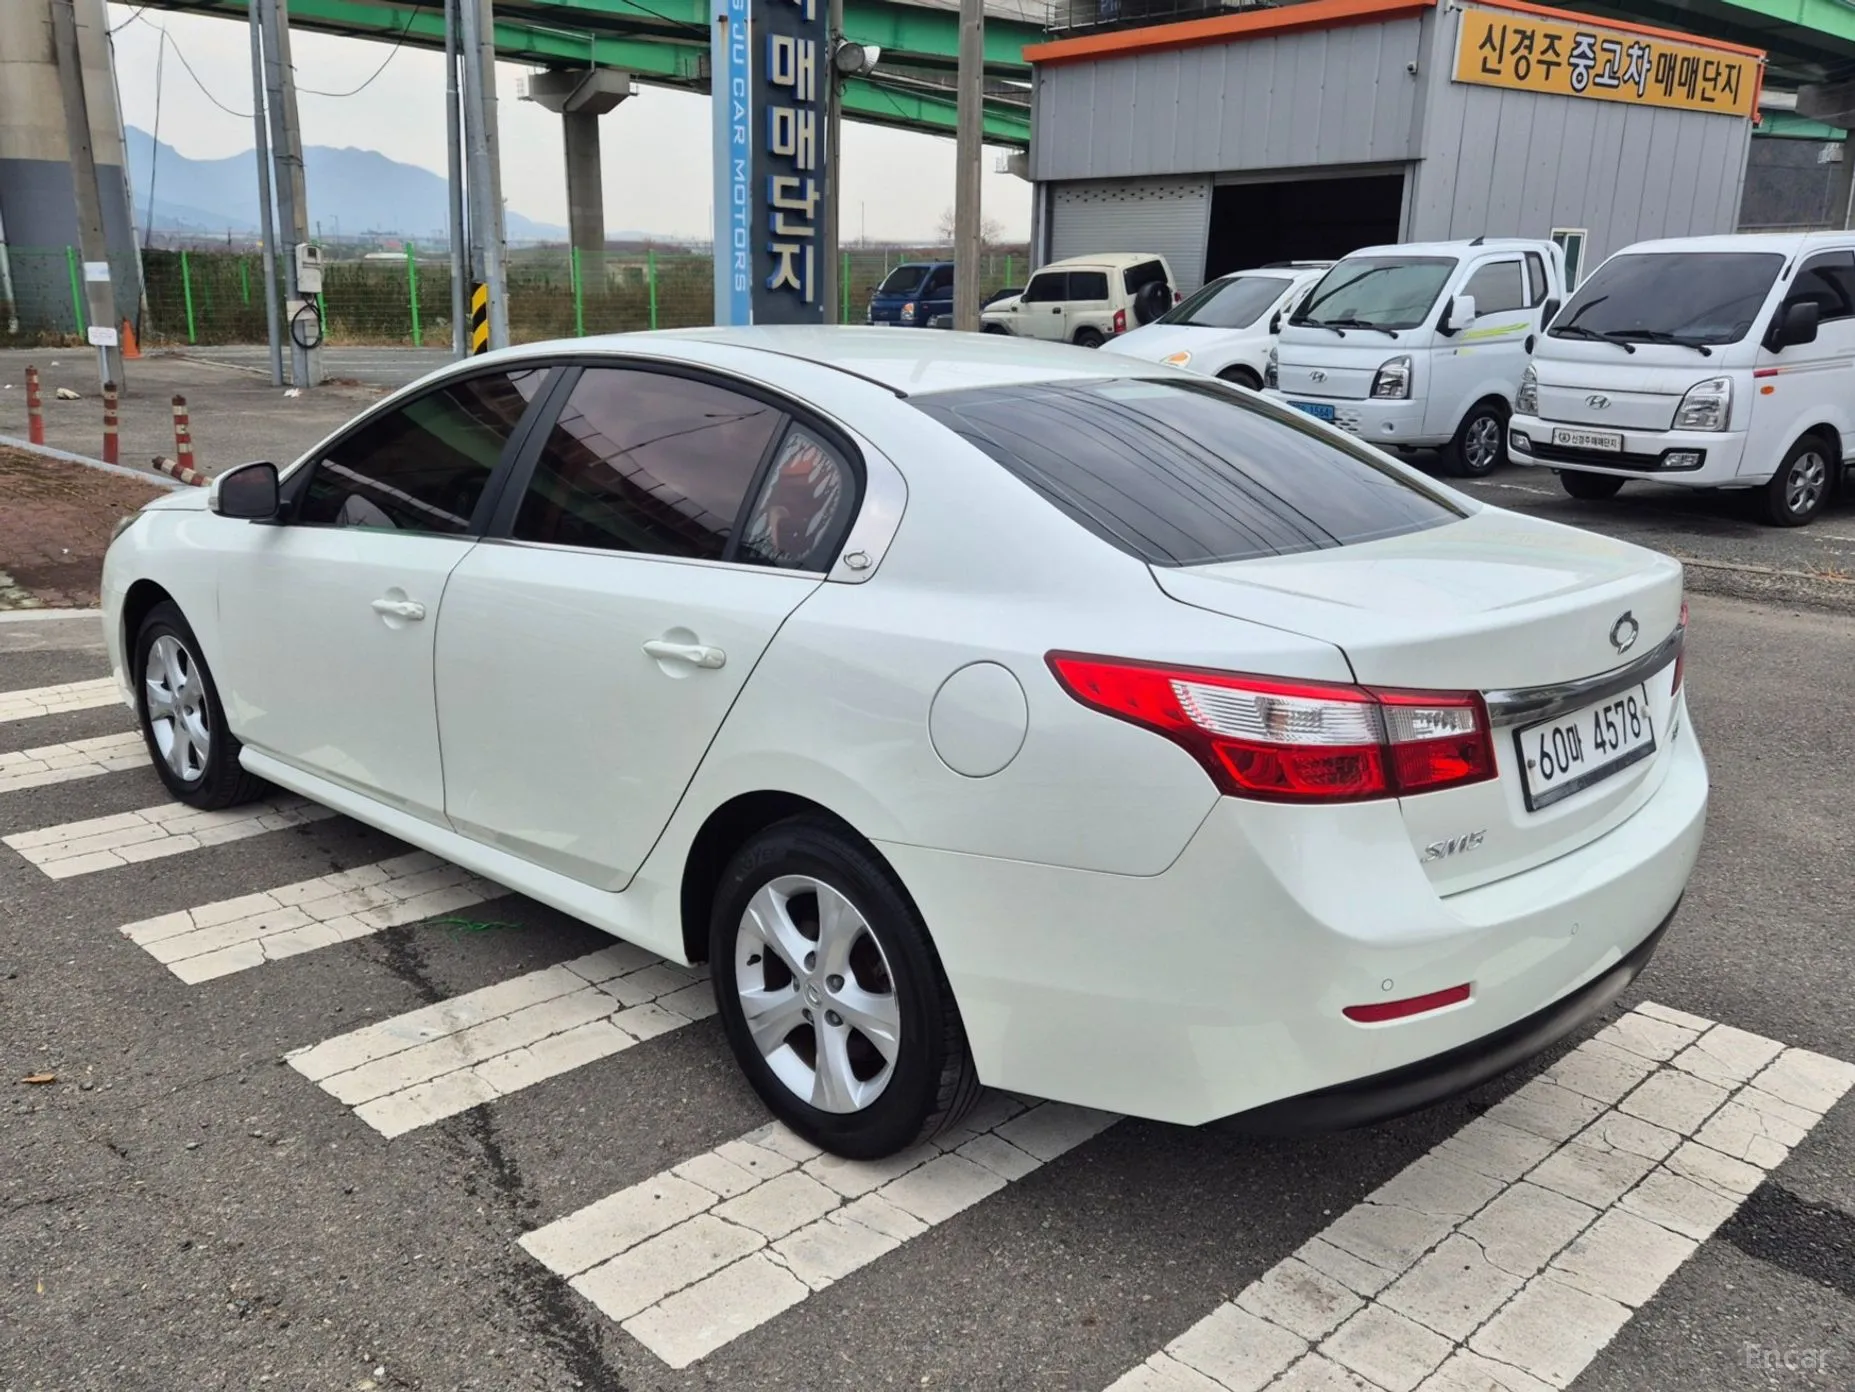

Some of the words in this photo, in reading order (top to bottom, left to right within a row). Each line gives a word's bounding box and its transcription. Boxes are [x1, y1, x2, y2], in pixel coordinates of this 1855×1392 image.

[732, 23, 745, 65] JU
[1478, 24, 1562, 82] 신경주
[1567, 31, 1652, 98] 중고차
[1654, 52, 1743, 106] 매매단지
[732, 81, 745, 144] CAR
[733, 159, 746, 292] MOTORS
[1539, 722, 1585, 781] 60마
[1593, 695, 1642, 755] 4578
[1421, 829, 1487, 862] SM5
